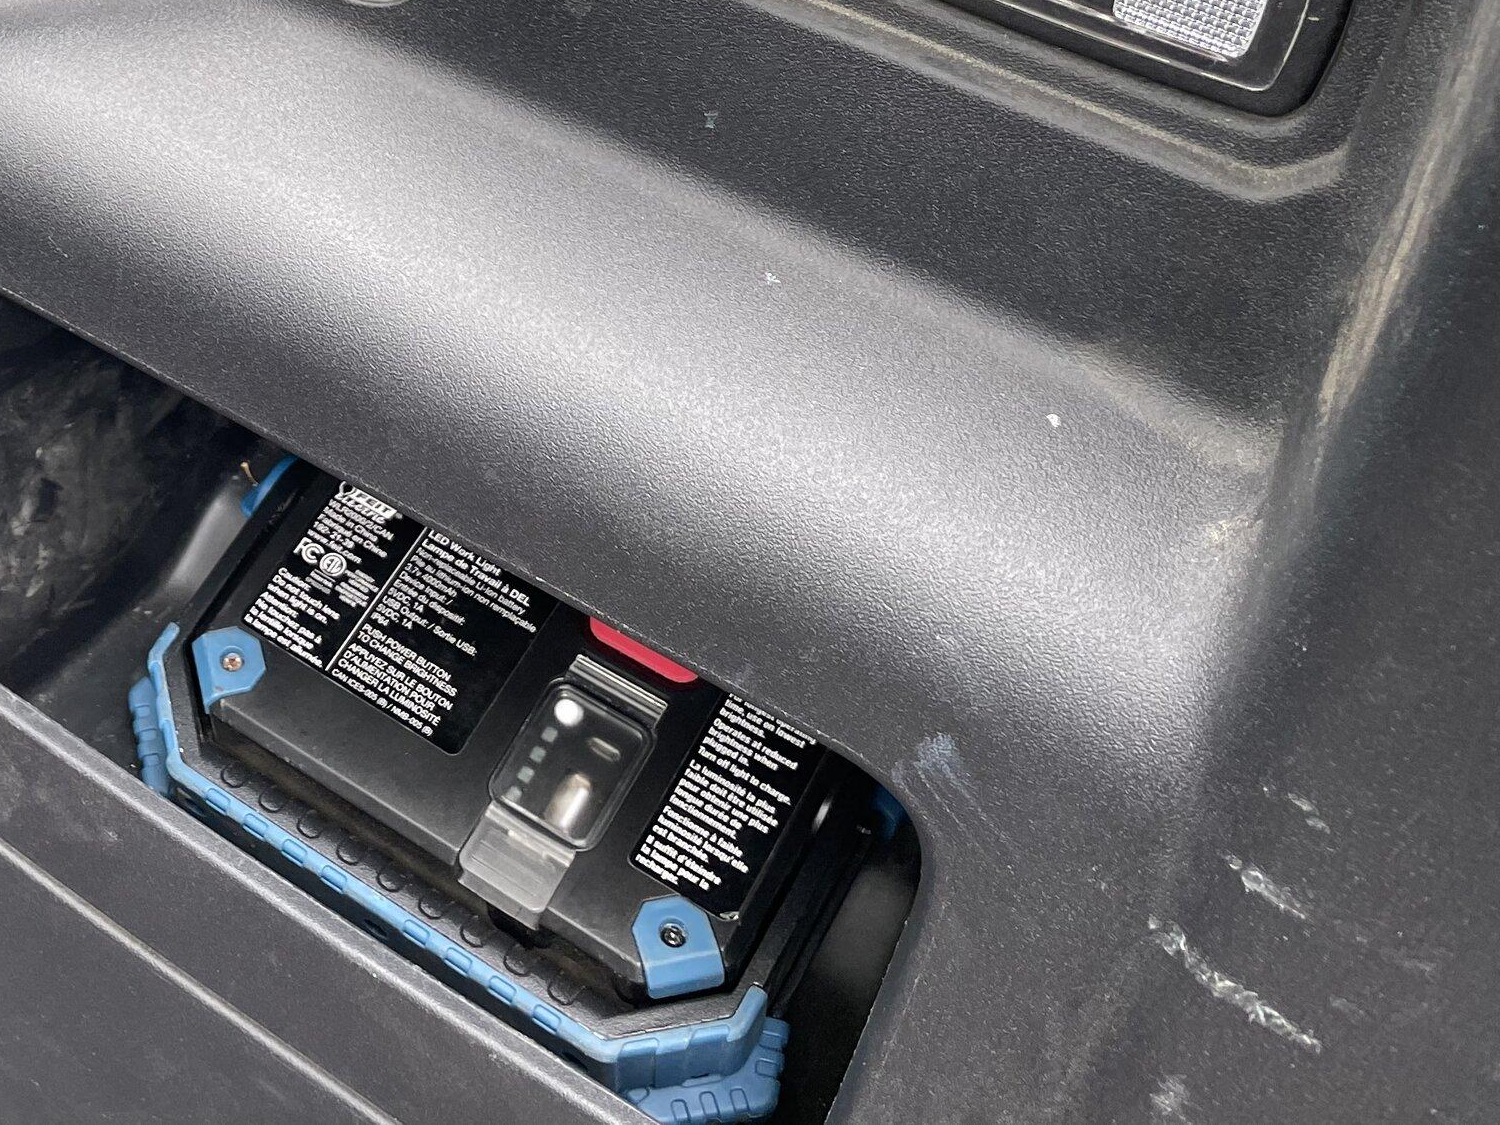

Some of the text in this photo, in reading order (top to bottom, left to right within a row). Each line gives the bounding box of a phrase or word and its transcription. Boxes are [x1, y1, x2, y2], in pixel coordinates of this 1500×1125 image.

[317, 513, 387, 558] Fabriqué en Chine
[322, 505, 378, 542] Made in China
[421, 538, 530, 607] Lampe de Travail à DEL
[427, 529, 501, 576] LED Work Light
[272, 574, 286, 586] Do
[284, 583, 301, 595] not
[298, 590, 323, 609] touch
[321, 604, 340, 620] lens
[278, 567, 311, 591] Caution:
[387, 586, 411, 606] 5VDC,
[412, 601, 424, 613] 1A
[393, 578, 465, 625] Entrée du dispositif:
[398, 570, 425, 590] Device
[424, 585, 447, 603] Input:
[404, 562, 457, 597] 3.7v 4000mAh
[409, 554, 536, 633] Pile au lithium-ion non remplaçable
[415, 546, 476, 585] Non-replaceable
[497, 594, 526, 615] battery
[254, 597, 322, 644] Ne touchez pas à
[259, 591, 299, 618] Attention:
[267, 583, 290, 600] when
[287, 595, 308, 611] light
[305, 606, 315, 616] is
[313, 612, 327, 624] on.
[370, 611, 389, 626] IP64
[375, 603, 412, 629] 5VDC, 1A
[382, 595, 401, 610] USB
[399, 606, 429, 627] Output:
[432, 625, 456, 644] Sortie
[455, 639, 477, 656] USB:
[243, 613, 322, 668] la lampe est allumée.
[249, 605, 314, 650] la lentille lorsque
[357, 630, 457, 696] TO CHANGE BRIGHTNESS
[361, 623, 451, 681] PUSH POWER BUTTON
[331, 668, 349, 682] CAN
[346, 677, 378, 701] ICES-005
[390, 705, 423, 729] NMB-005
[337, 658, 441, 726] CHANGER LA LUMINOSITÉ
[343, 650, 435, 711] D'ALIMENTATION POUR
[348, 642, 453, 710] APPUYEZ SUR LE BOUTON
[713, 717, 798, 770] Operates at reduced
[719, 707, 765, 738] brightness.
[724, 698, 805, 748] time, use on lowest
[775, 718, 816, 745] operating
[702, 736, 749, 767] plugged in.
[708, 726, 778, 771] brightness when
[684, 768, 778, 827] faible doit être utilisée
[689, 759, 776, 814] La luminosité la plus
[697, 745, 791, 805] Turn off light to charge.
[669, 794, 736, 840] fonctionnement.
[673, 785, 742, 830] longue durée de
[678, 777, 769, 834] pour obtenir une plus
[652, 824, 709, 863] est branchée.
[657, 814, 749, 873] luminosité lorsqu'elle
[662, 805, 743, 858] Fonctionne à faible
[640, 843, 709, 891] la lampe pour la
[645, 834, 721, 885] Il suffit d'éteindre
